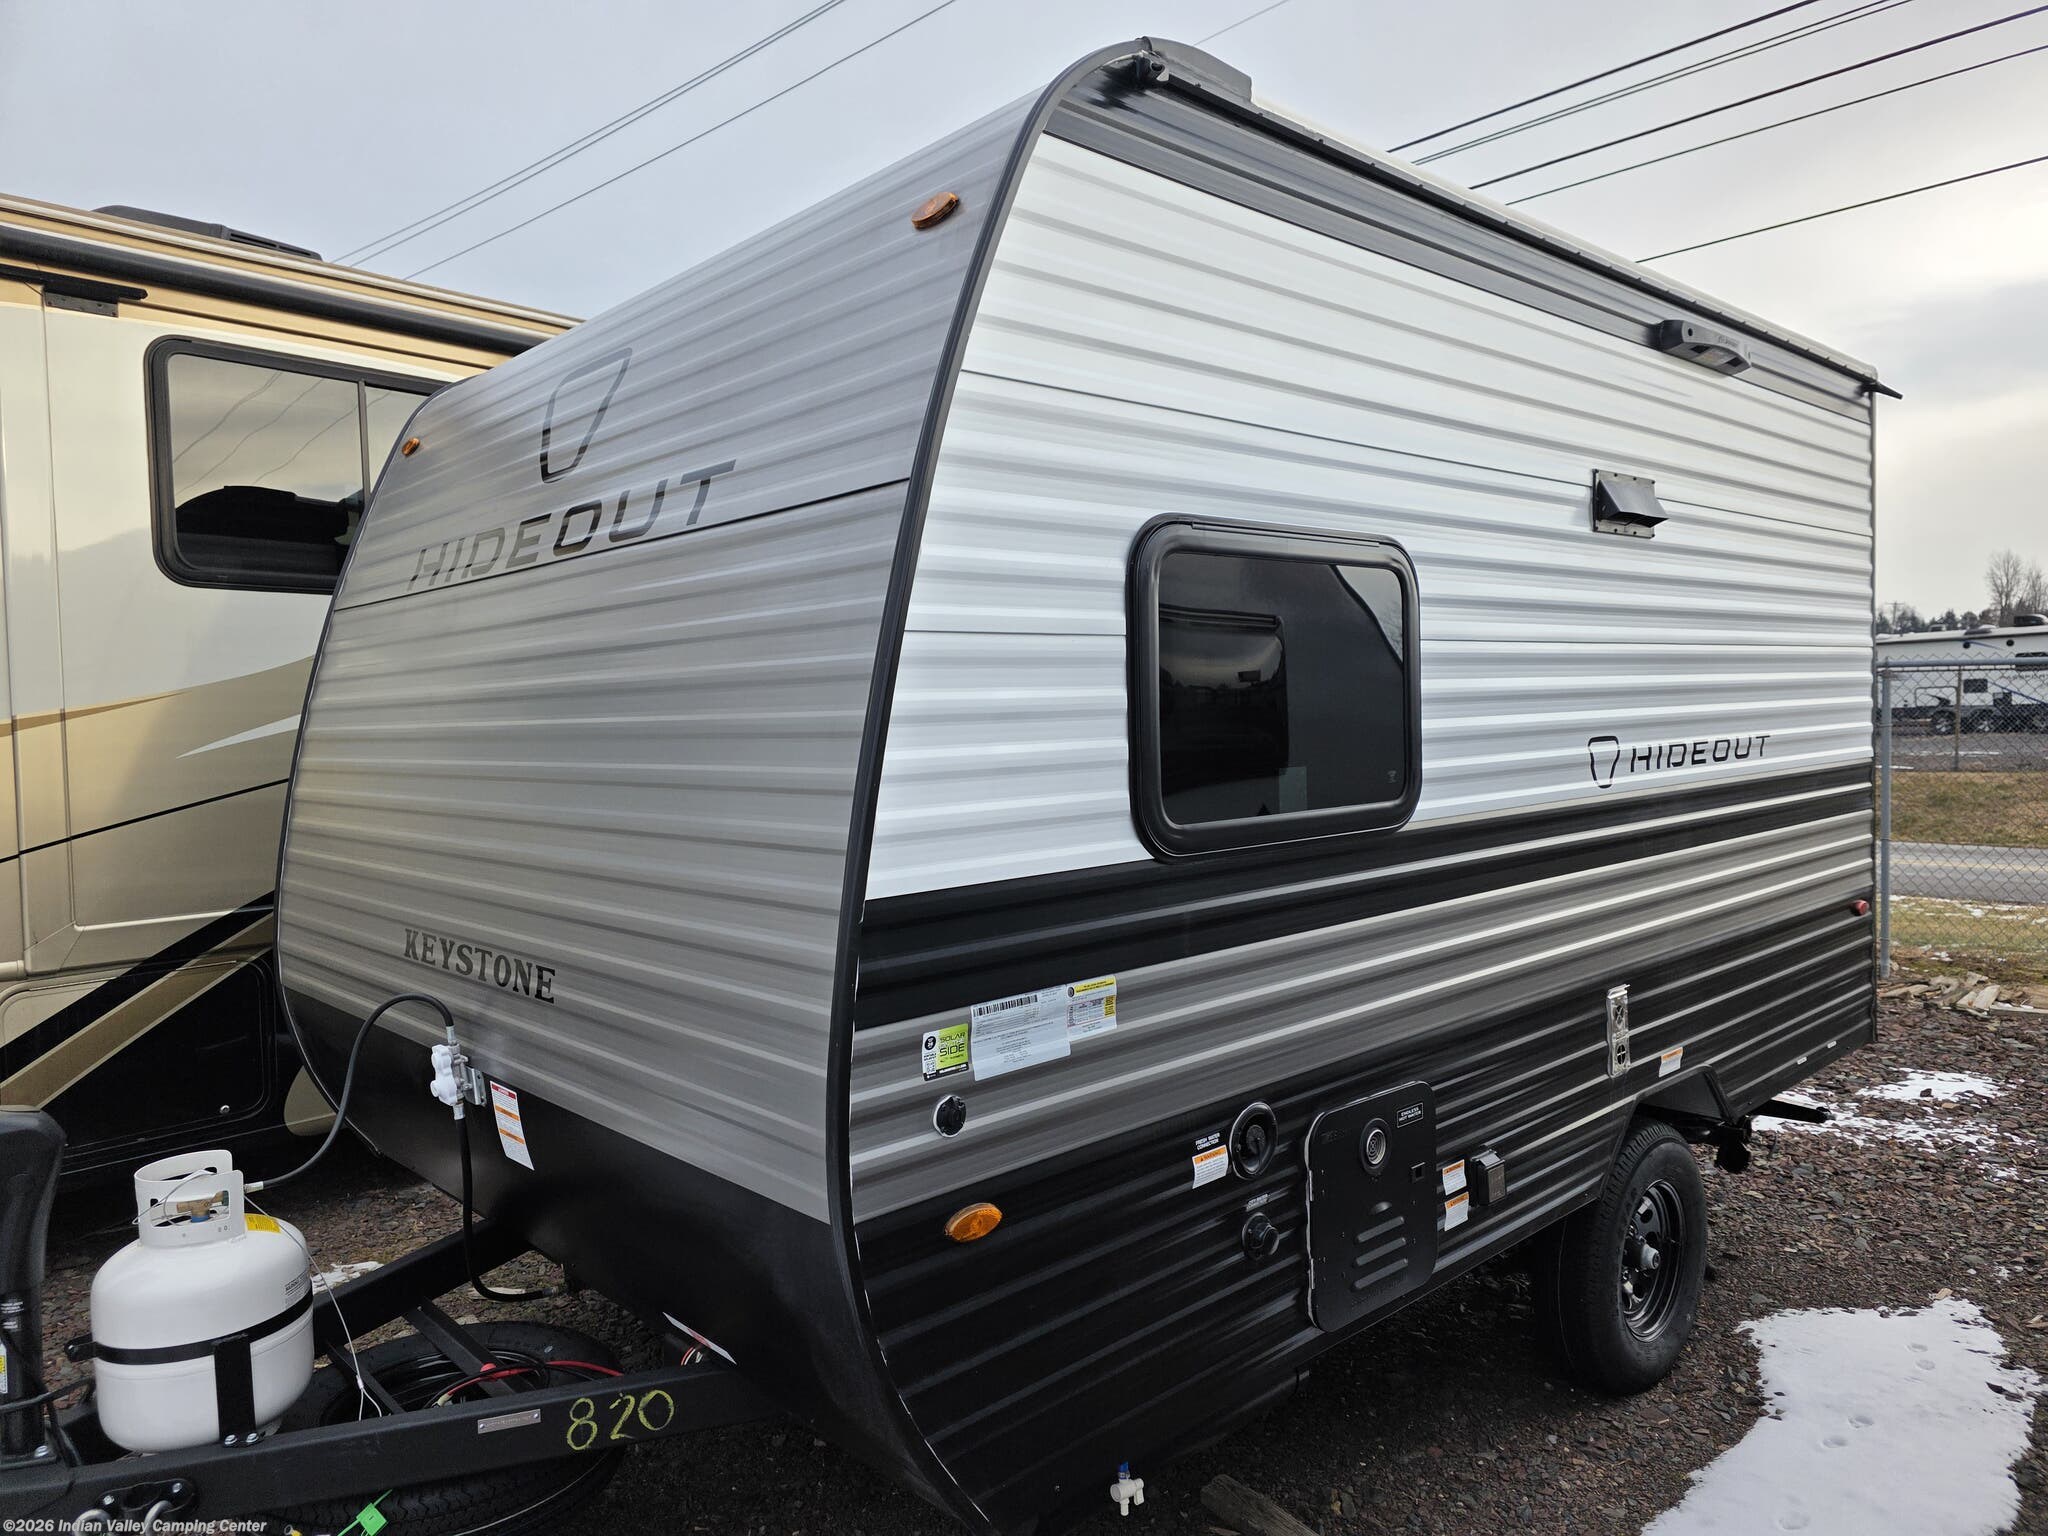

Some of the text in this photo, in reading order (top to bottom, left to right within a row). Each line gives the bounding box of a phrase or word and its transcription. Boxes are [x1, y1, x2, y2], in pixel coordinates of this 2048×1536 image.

[407, 459, 736, 591] HIDEOUT
[1630, 735, 1771, 773] HIDEOUT
[403, 928, 556, 1004] KEYSTONE
[940, 1043, 965, 1057] SIDE
[566, 1389, 675, 1451] 820
